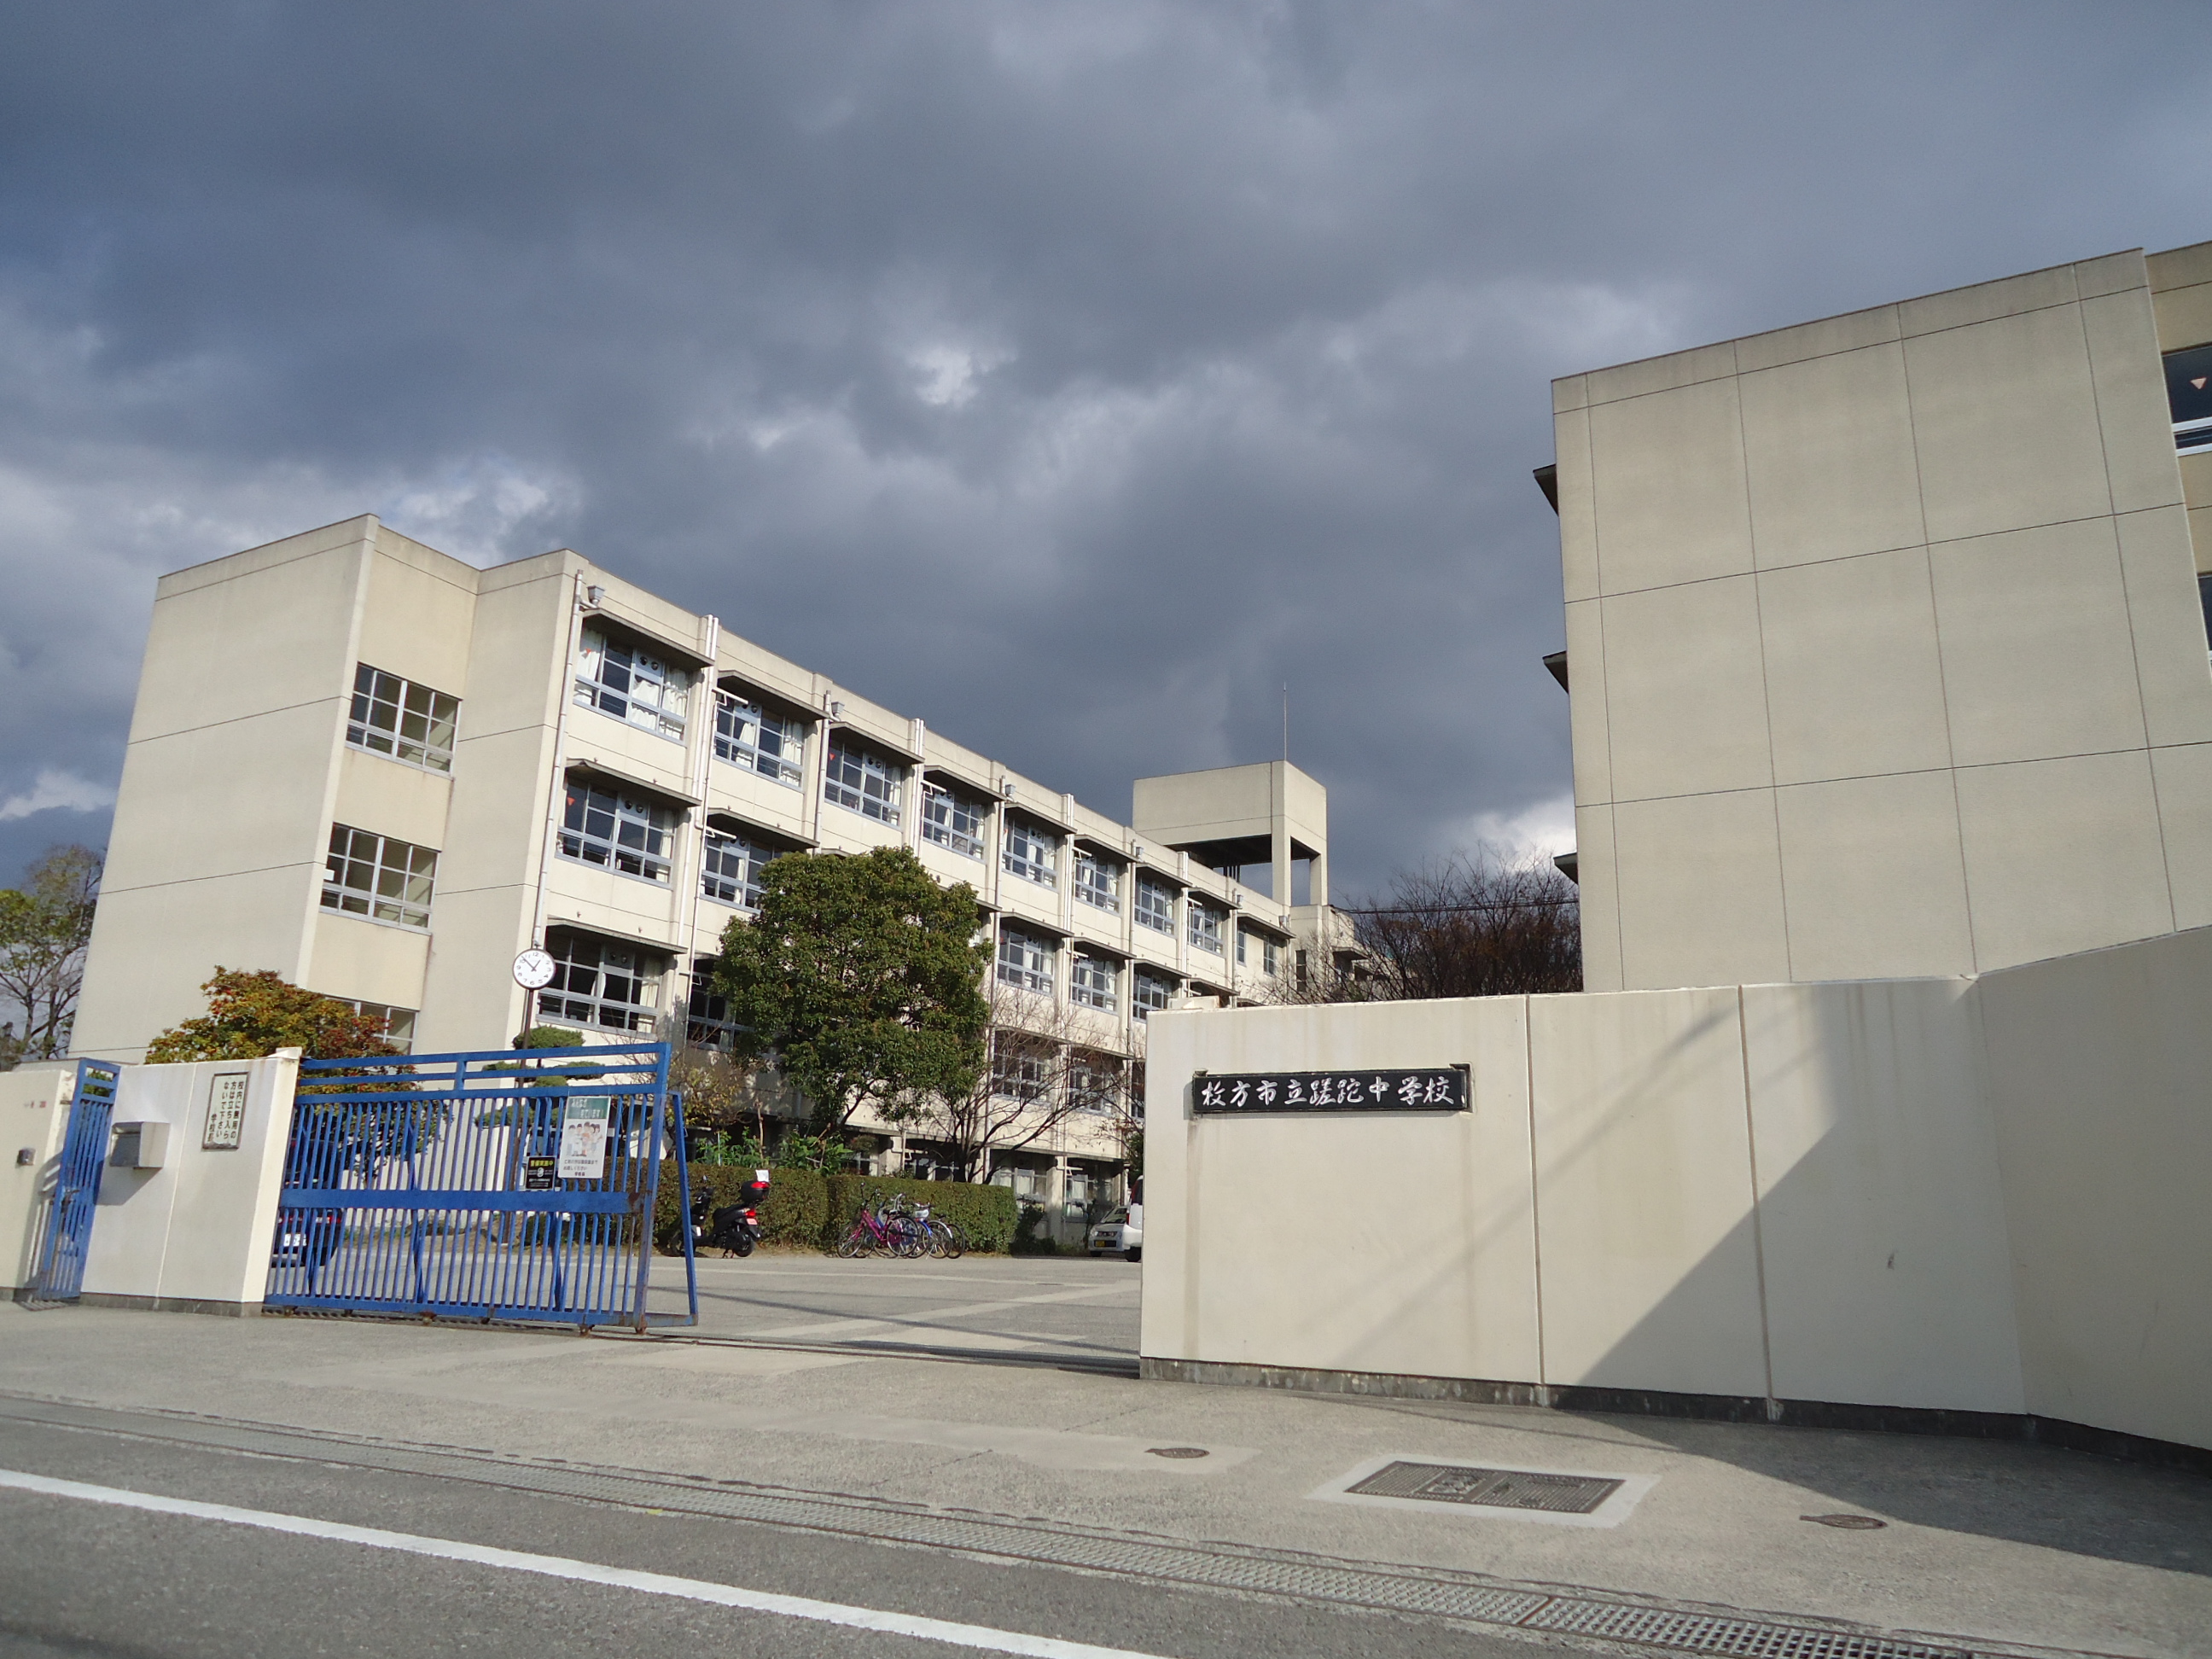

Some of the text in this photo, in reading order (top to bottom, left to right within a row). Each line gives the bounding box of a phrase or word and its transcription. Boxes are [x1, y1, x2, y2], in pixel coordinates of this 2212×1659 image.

[216, 1081, 229, 1138] ないで下さい
[224, 1081, 236, 1139] 方は立ち入ら
[230, 1081, 244, 1139] 校内に無用の
[1201, 1075, 1454, 1107] 枚方市立蹉跎中学校
